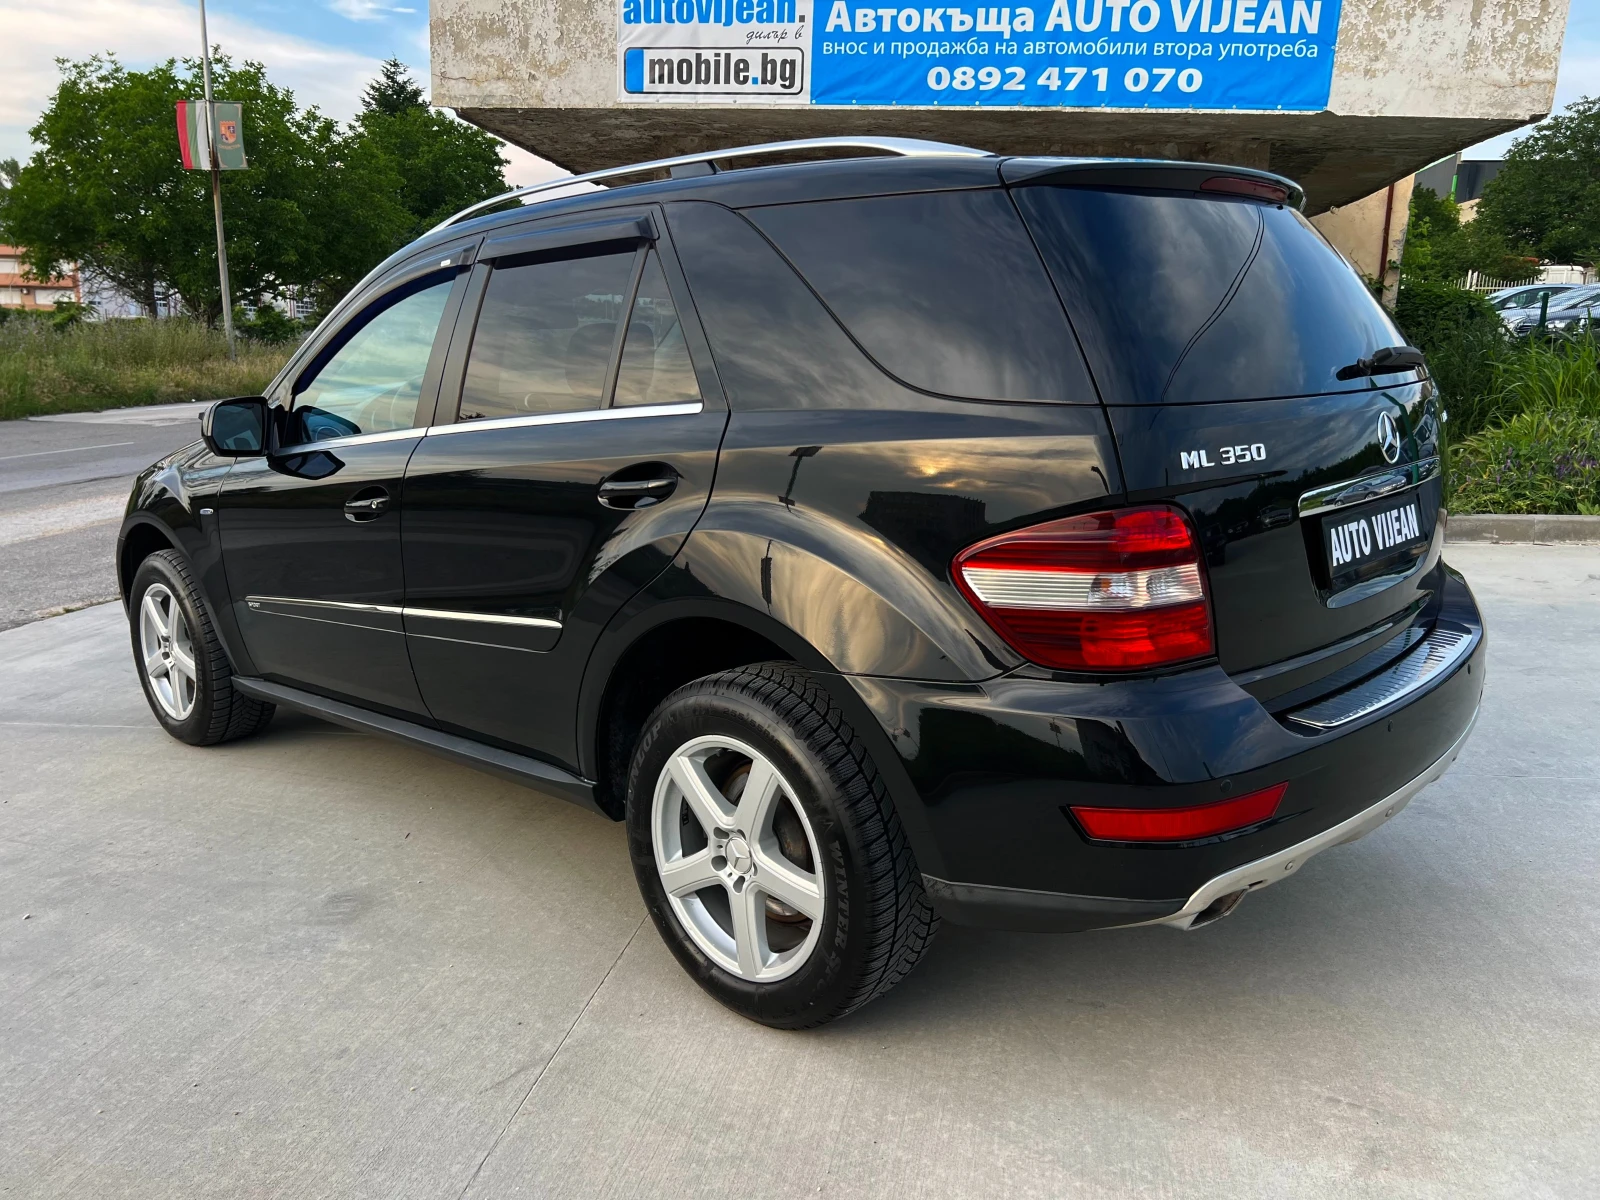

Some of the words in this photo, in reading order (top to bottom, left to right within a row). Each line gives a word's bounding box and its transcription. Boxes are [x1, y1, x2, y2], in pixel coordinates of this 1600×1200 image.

[824, 0, 1035, 40] Автокъща
[1044, 0, 1161, 33] AUTO
[1170, 0, 1322, 34] VIJEAN
[745, 29, 789, 45] дилър
[823, 41, 868, 55] внос
[873, 41, 885, 55] и
[890, 37, 989, 59] продажба
[995, 41, 1018, 55] на
[1023, 37, 1147, 56] автомобили
[1153, 42, 1212, 60] втора
[1218, 39, 1318, 61] употреба
[648, 53, 797, 90] mobile.bg
[927, 66, 1026, 91] 0892
[1037, 67, 1109, 92] 471
[1124, 67, 1203, 93] 070
[1180, 450, 1215, 470] ML
[1219, 443, 1267, 465] 350
[1330, 519, 1371, 567] AUTO
[1371, 503, 1420, 551] VIJEAN
[828, 840, 850, 950] WINTER
